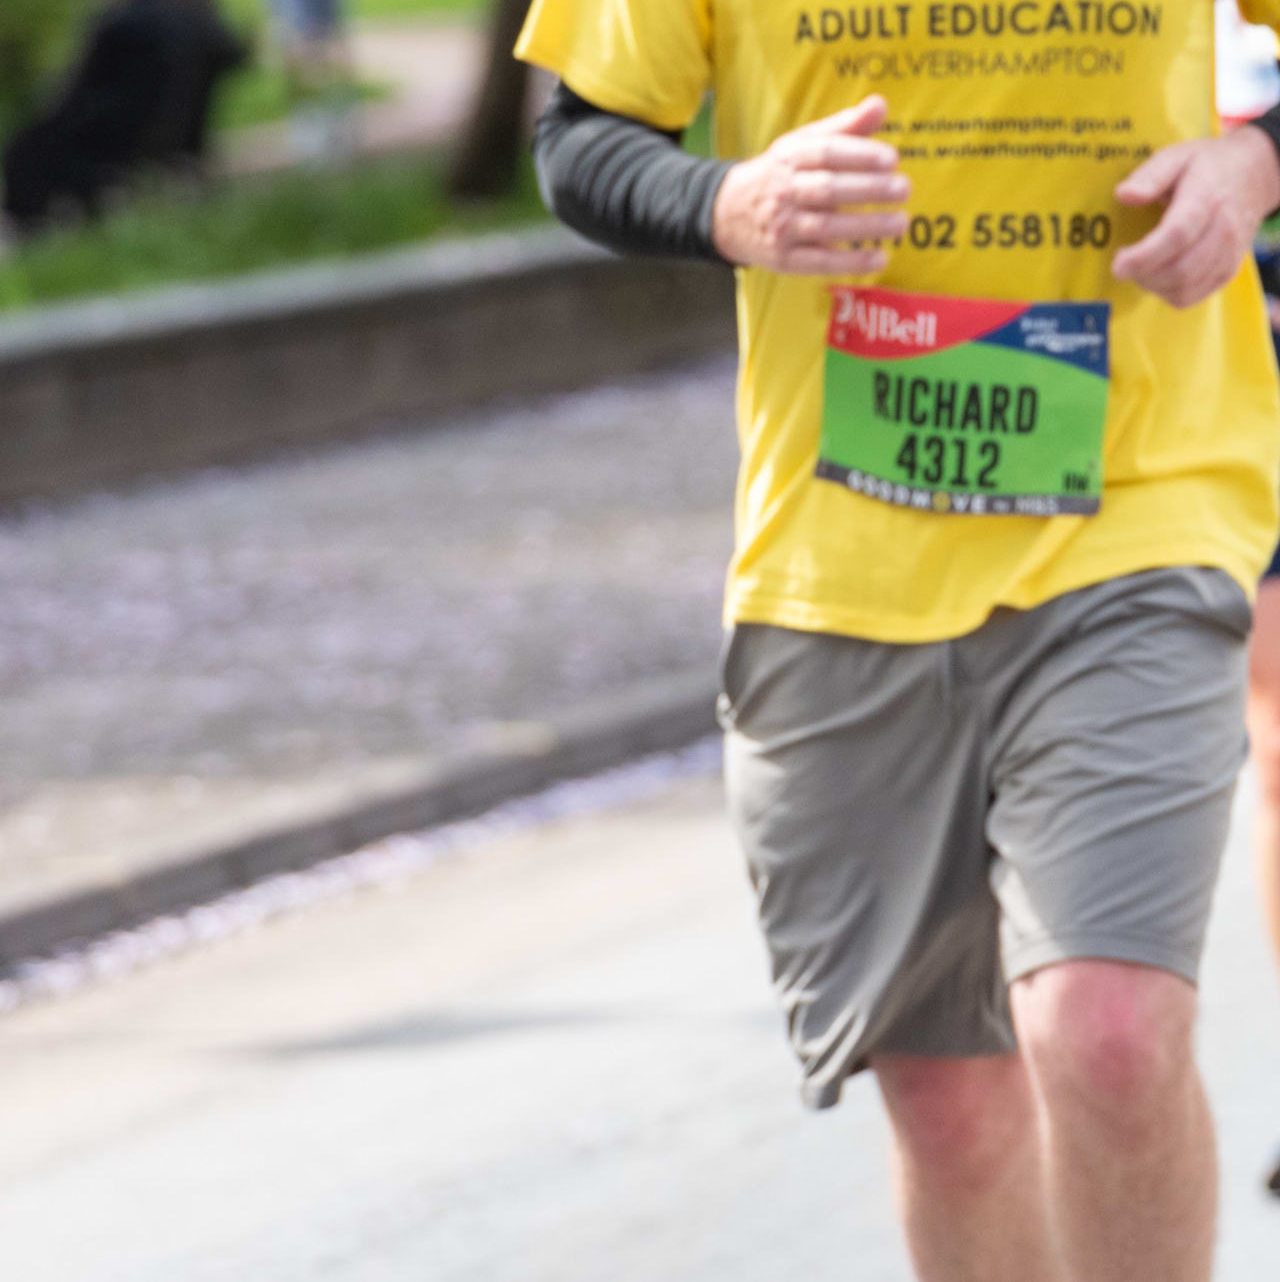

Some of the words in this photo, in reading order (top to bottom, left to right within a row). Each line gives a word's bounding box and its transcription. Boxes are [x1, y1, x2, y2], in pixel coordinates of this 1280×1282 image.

[795, 4, 911, 43] ADULT
[927, 0, 1162, 38] EDUCATION
[832, 45, 1126, 81] WOLVERHAMPTON
[972, 213, 1112, 249] 558180
[873, 370, 1038, 435] RICHARD
[896, 433, 1001, 488] 4312
